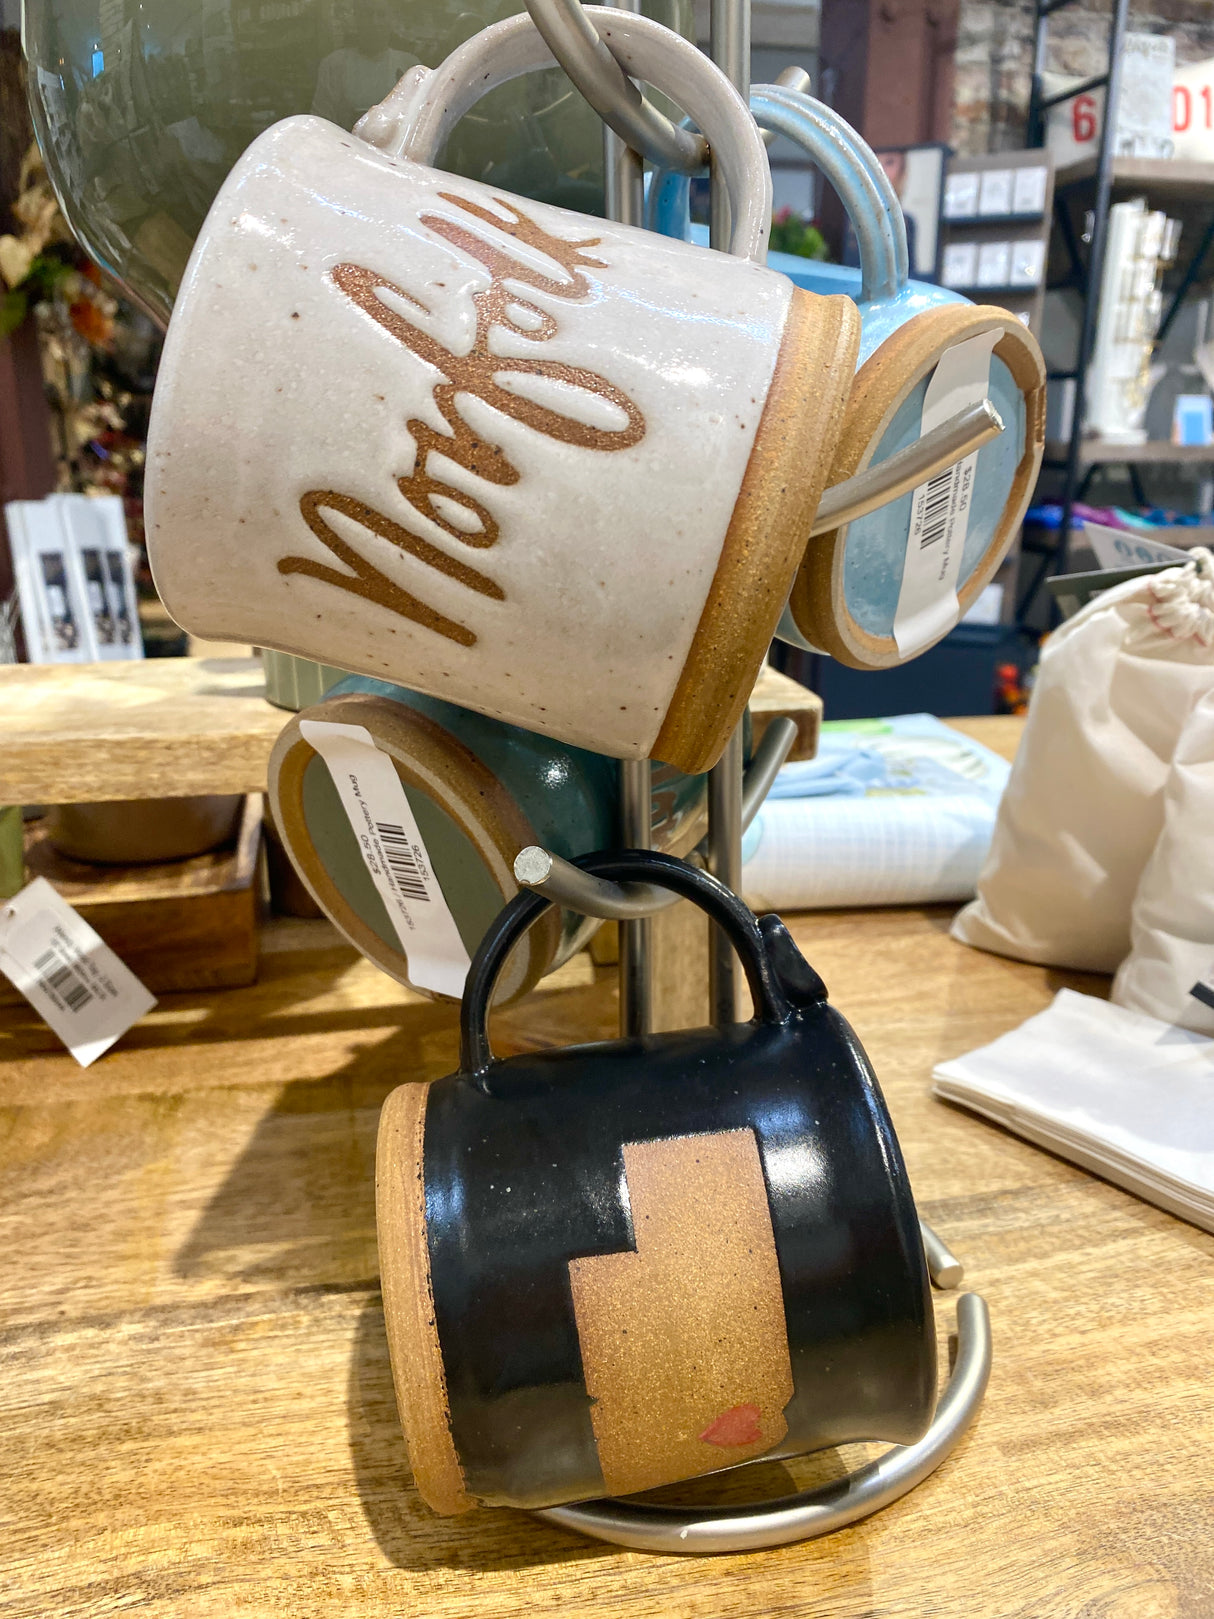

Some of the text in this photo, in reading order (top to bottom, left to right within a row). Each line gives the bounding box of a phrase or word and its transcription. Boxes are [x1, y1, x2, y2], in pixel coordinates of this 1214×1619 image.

[1072, 95, 1097, 143] 6
[277, 191, 647, 648] Norfolk
[960, 465, 972, 512] $28.50
[914, 494, 926, 536] 153726
[349, 774, 362, 798] Mug
[359, 799, 376, 836] Pottery
[361, 834, 381, 875] $28.50
[373, 839, 396, 892] Handmade
[411, 844, 430, 881] 153726
